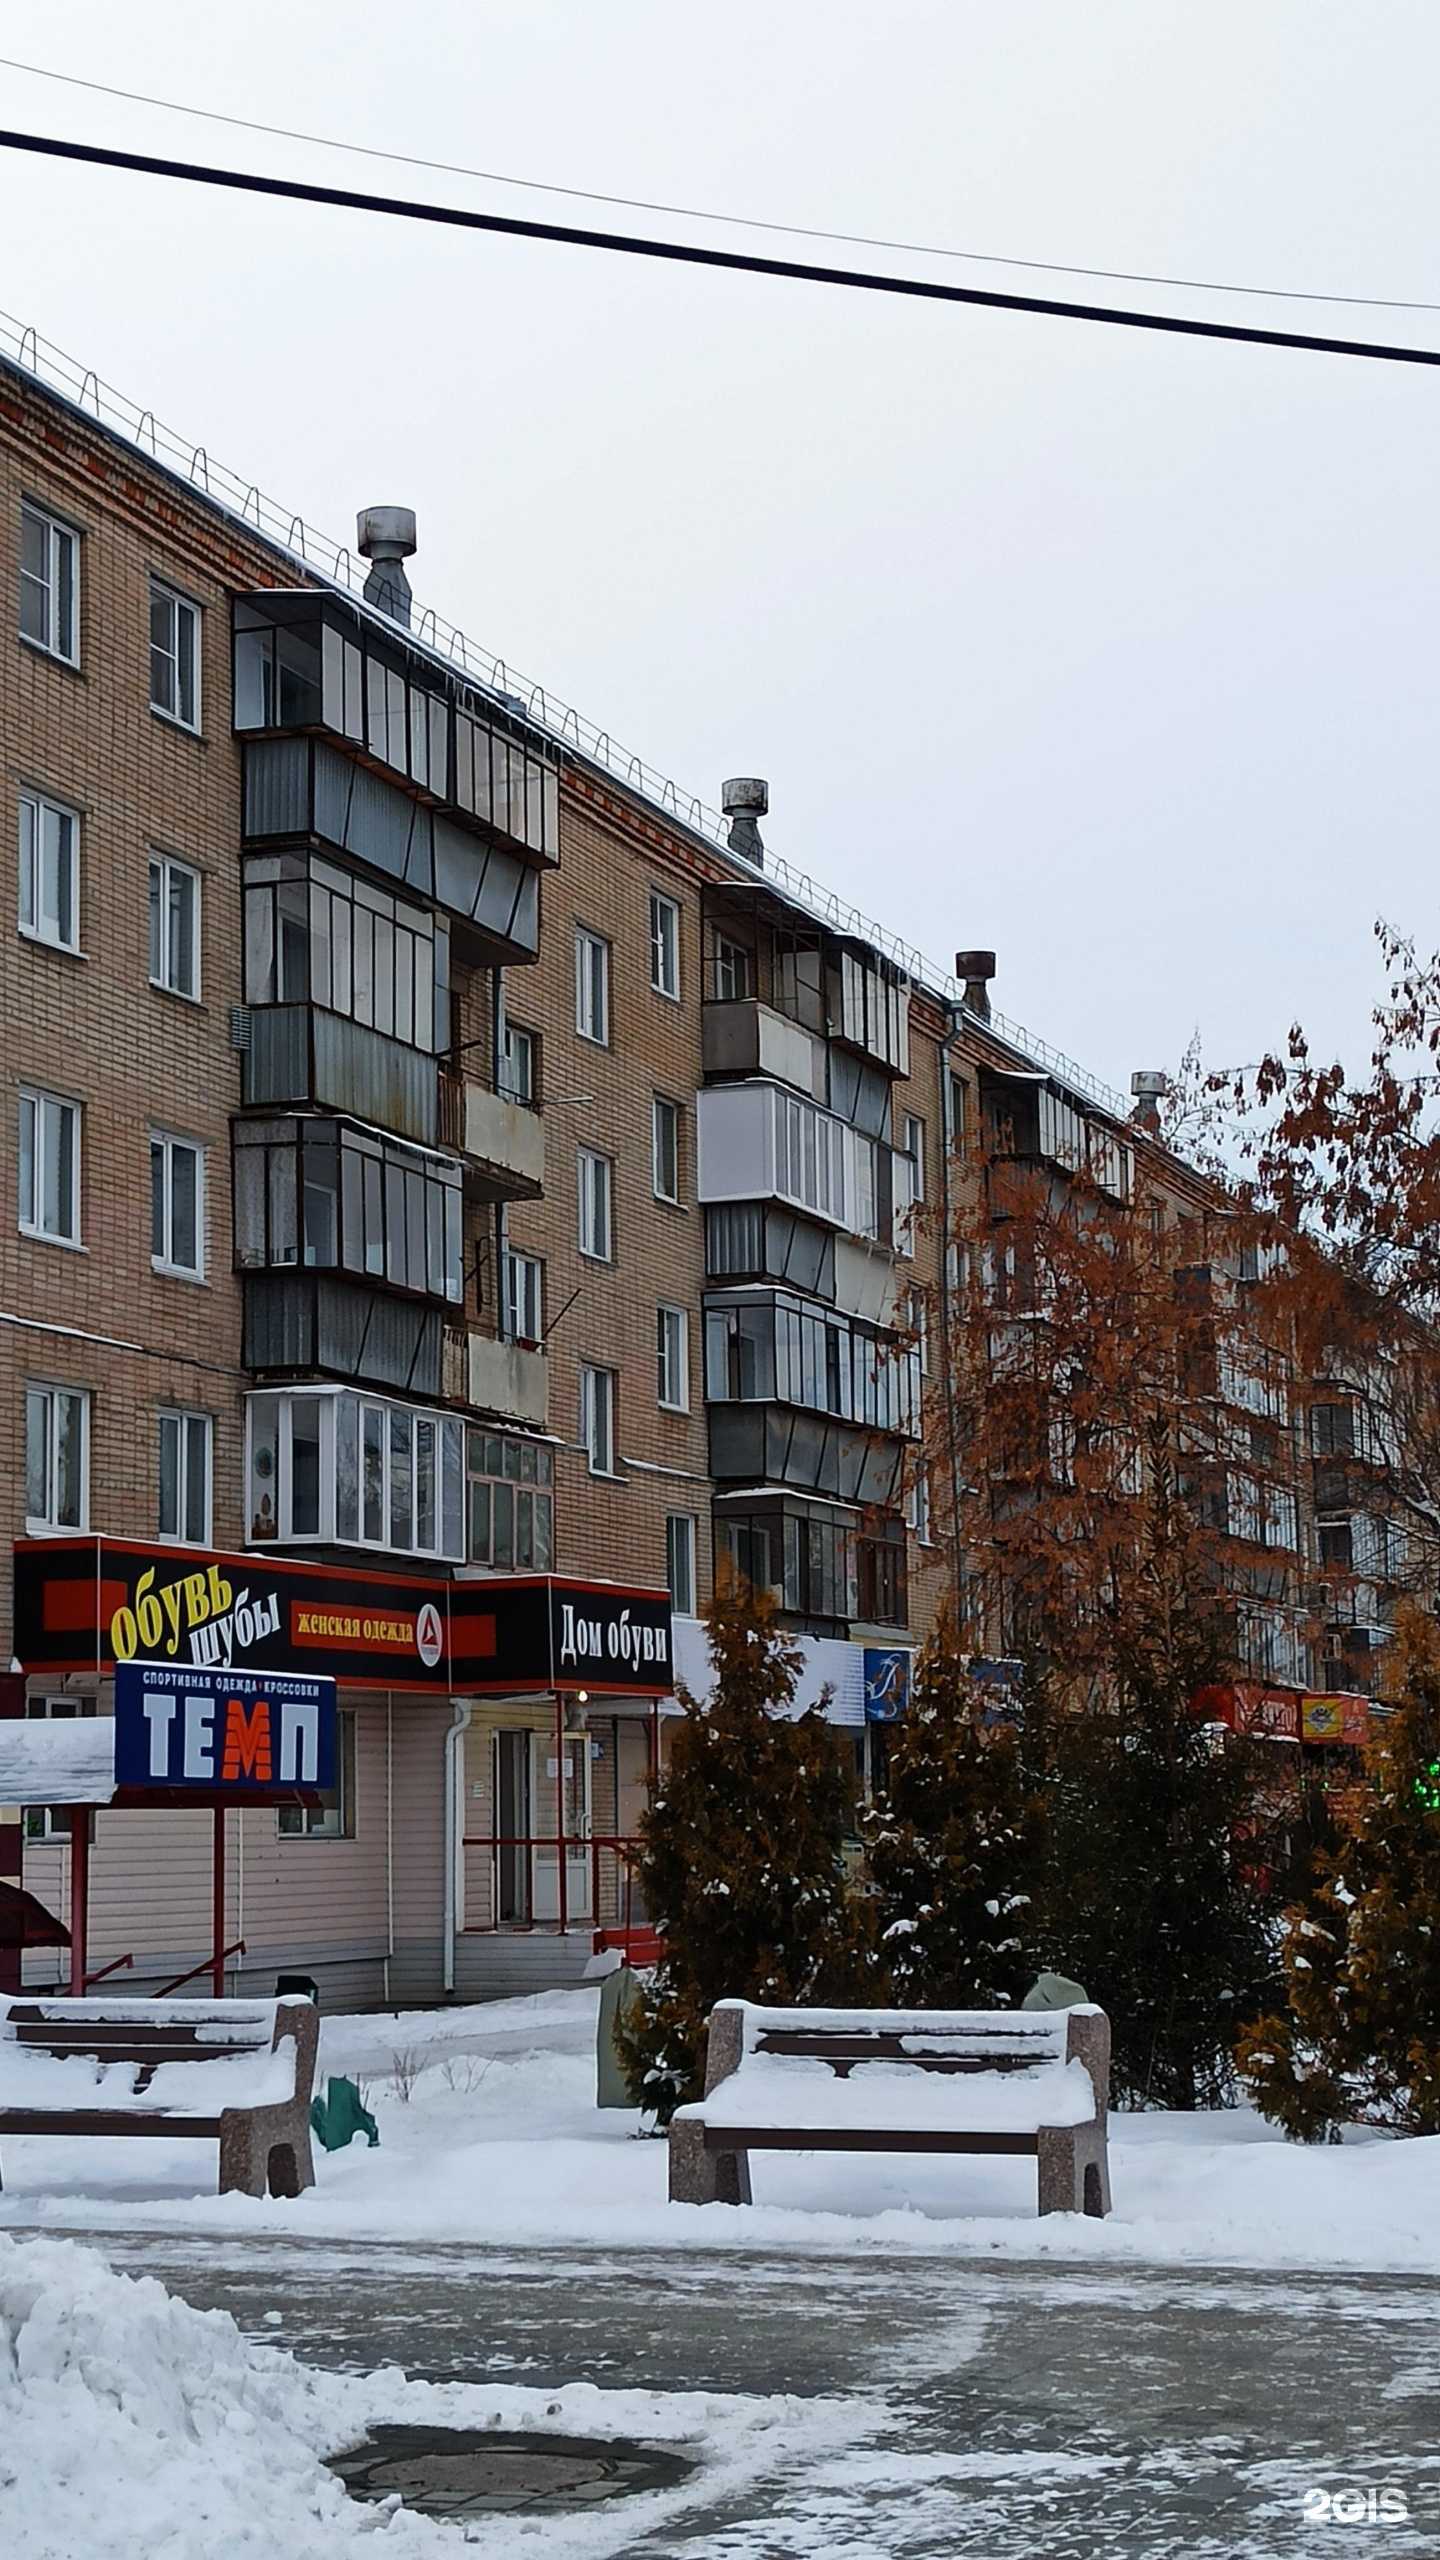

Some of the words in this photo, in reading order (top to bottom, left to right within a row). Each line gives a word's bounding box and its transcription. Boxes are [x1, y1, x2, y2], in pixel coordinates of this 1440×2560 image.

[188, 1587, 281, 1669] шубы
[363, 1619, 414, 1643] одежда
[561, 1604, 602, 1666] Дом
[608, 1608, 667, 1672] обуви
[143, 1671, 211, 1689] СПОРТИВНАЯ
[216, 1678, 257, 1693] ОДЕЖДА
[264, 1681, 320, 1697] КРОССОВКИ
[143, 1693, 319, 1782] ТЕМП
